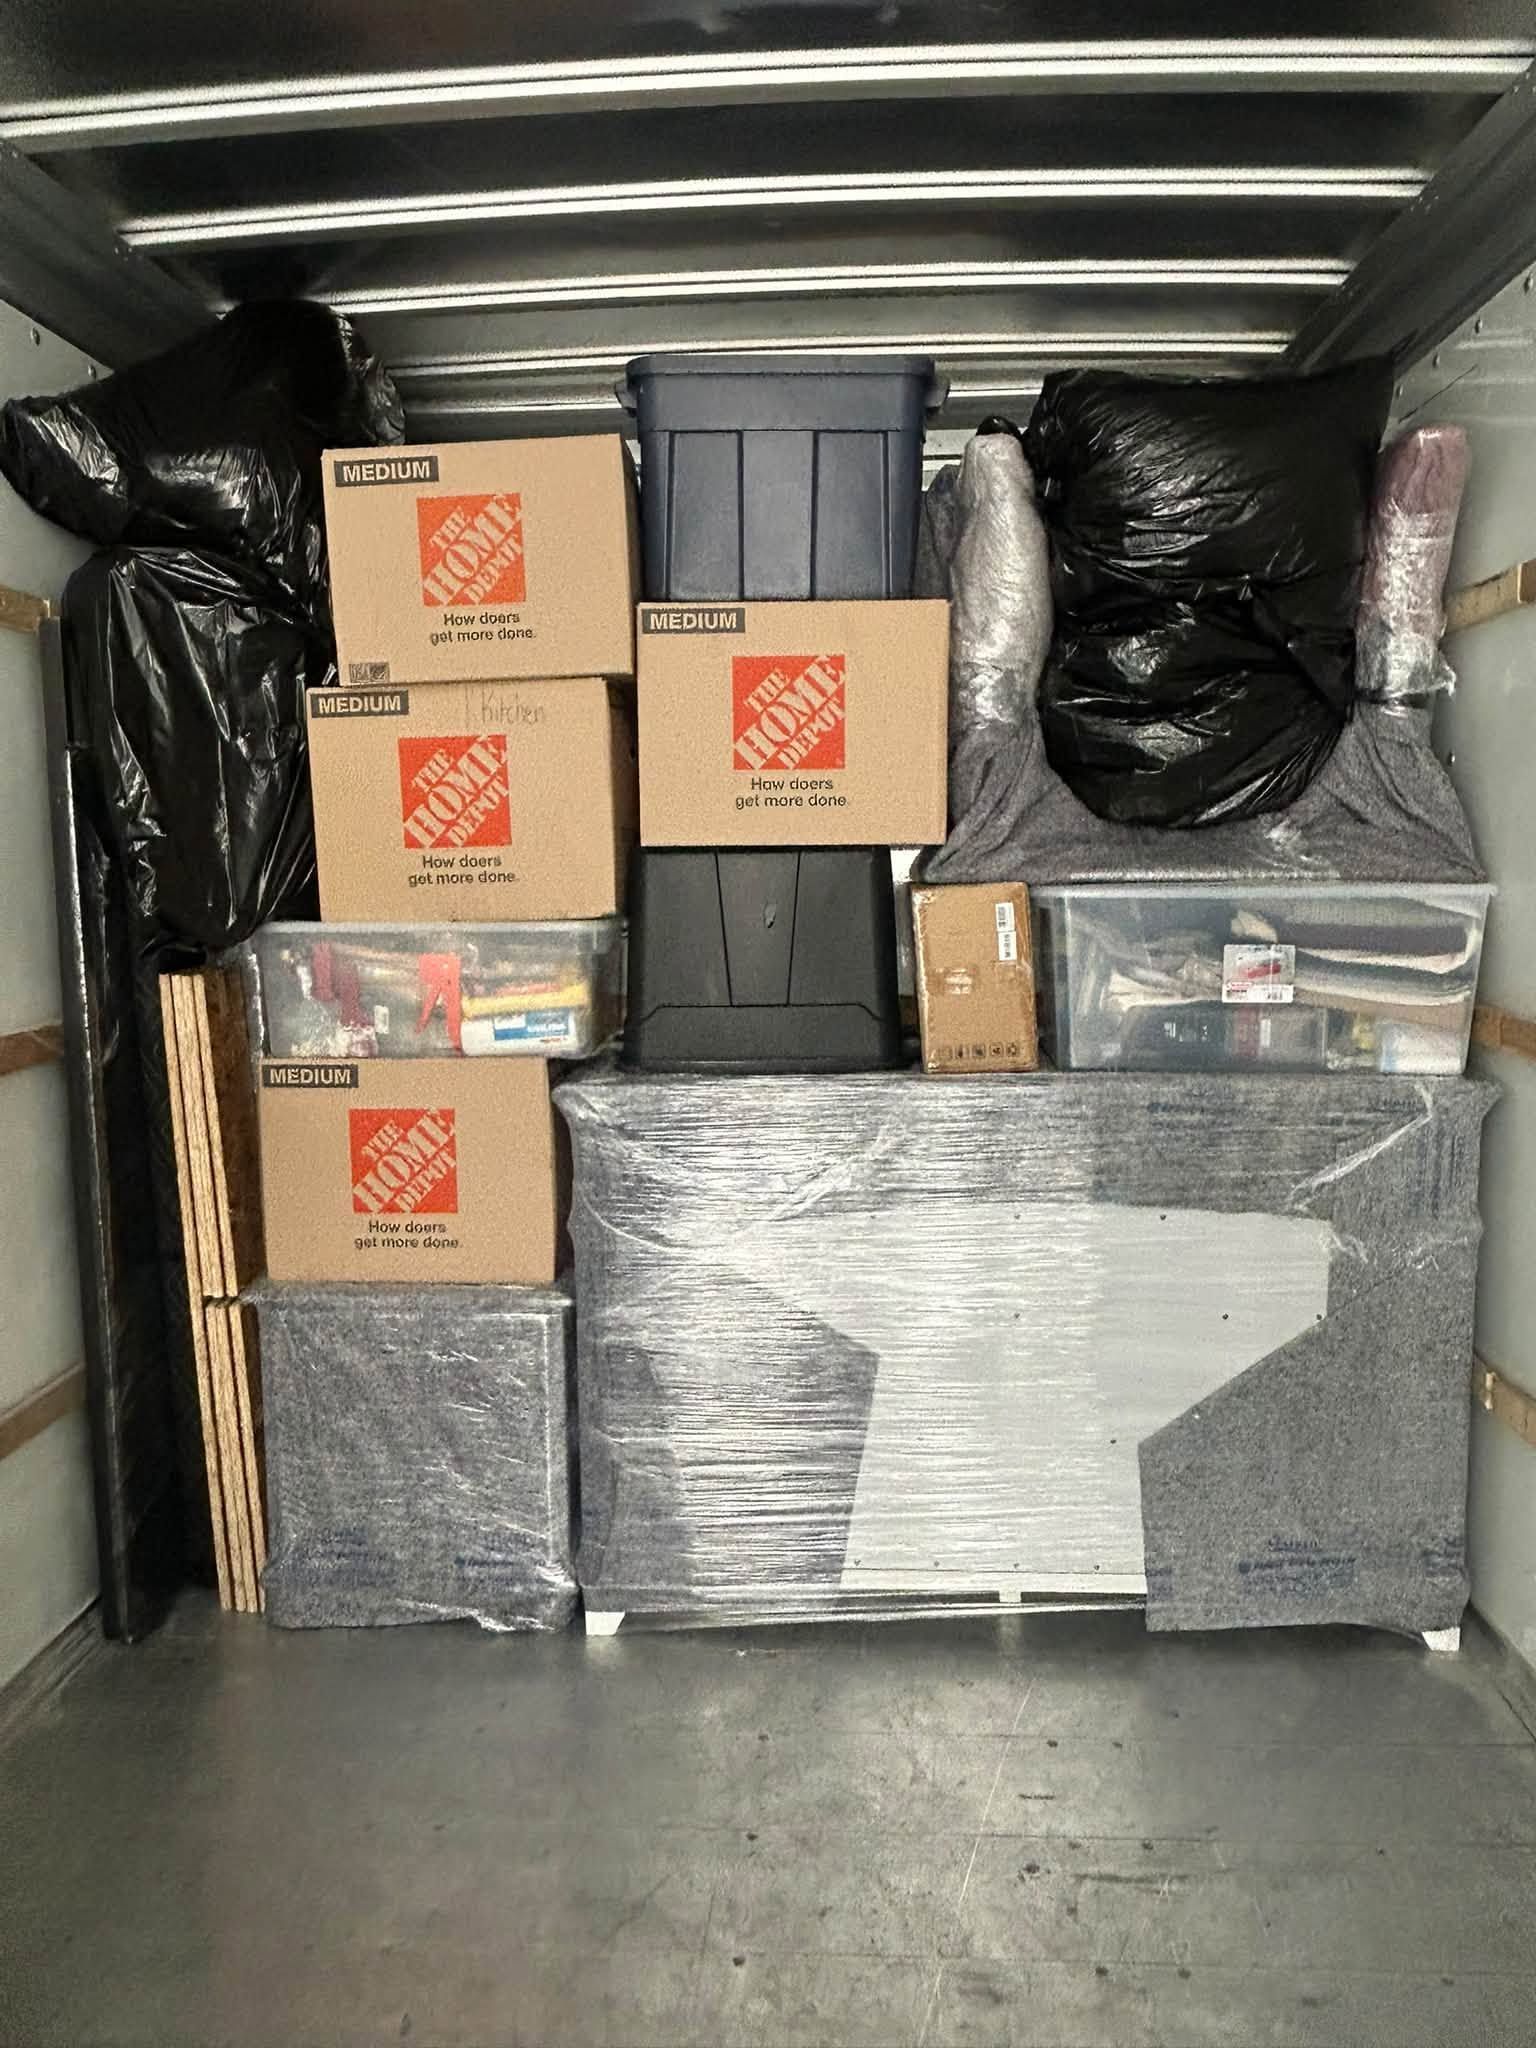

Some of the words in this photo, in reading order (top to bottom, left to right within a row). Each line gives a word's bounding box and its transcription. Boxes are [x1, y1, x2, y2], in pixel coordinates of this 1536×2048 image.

[342, 460, 432, 482] MEDIUM
[430, 506, 471, 550] THE
[424, 494, 521, 606] HOME
[465, 535, 523, 603] DEPOT
[443, 612, 475, 626] How
[479, 611, 521, 624] doers
[650, 613, 738, 631] MEDIUM
[430, 629, 453, 646] get
[457, 629, 494, 642] more
[497, 626, 538, 640] done.
[318, 696, 401, 715] MEDIUM
[744, 668, 791, 713] THE
[735, 656, 846, 770] HOME
[777, 699, 847, 770] DEPOT
[411, 748, 454, 792] THE
[751, 777, 785, 791] How
[789, 777, 834, 791] doers
[404, 735, 507, 848] HOME
[736, 794, 760, 810] get
[764, 794, 804, 807] more
[447, 776, 508, 846] DEPOT
[422, 855, 455, 869] How
[459, 854, 502, 868] doers
[408, 874, 433, 888] get
[436, 873, 474, 885] more
[270, 1068, 351, 1085] MEDIUM
[361, 1119, 405, 1161] THE
[352, 1105, 455, 1214] HOME
[394, 1149, 456, 1213] DEPOT
[369, 1220, 400, 1233] How
[405, 1219, 446, 1234] doers
[354, 1238, 377, 1249] get
[381, 1238, 418, 1249] more
